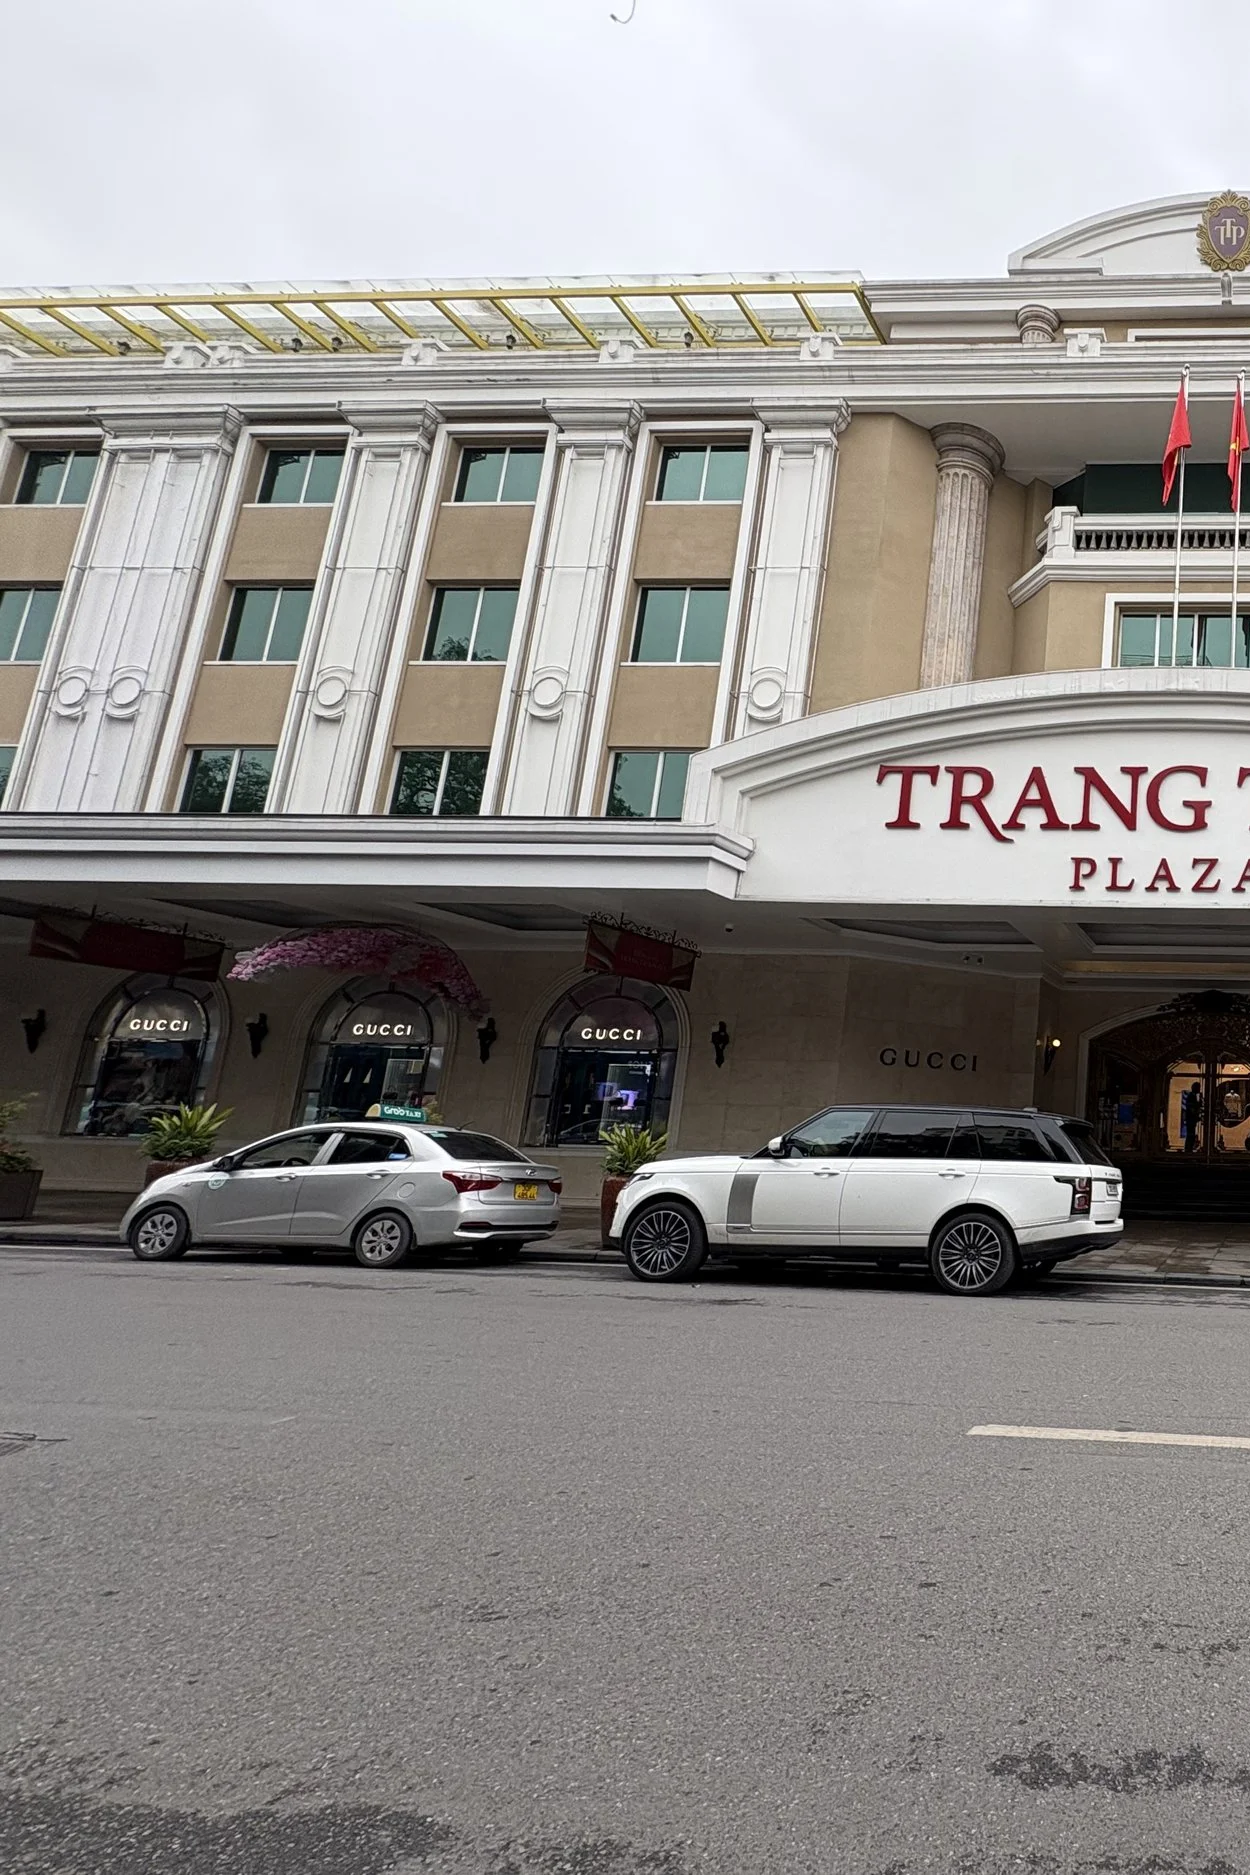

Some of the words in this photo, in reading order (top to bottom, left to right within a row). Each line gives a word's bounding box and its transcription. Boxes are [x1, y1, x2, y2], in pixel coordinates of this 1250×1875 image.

[876, 764, 1212, 843] TRANG
[129, 1018, 190, 1032] GUCCI
[352, 1023, 413, 1037] GUCCI
[580, 1027, 643, 1041] GUCCI
[879, 1047, 979, 1072] GUCCI
